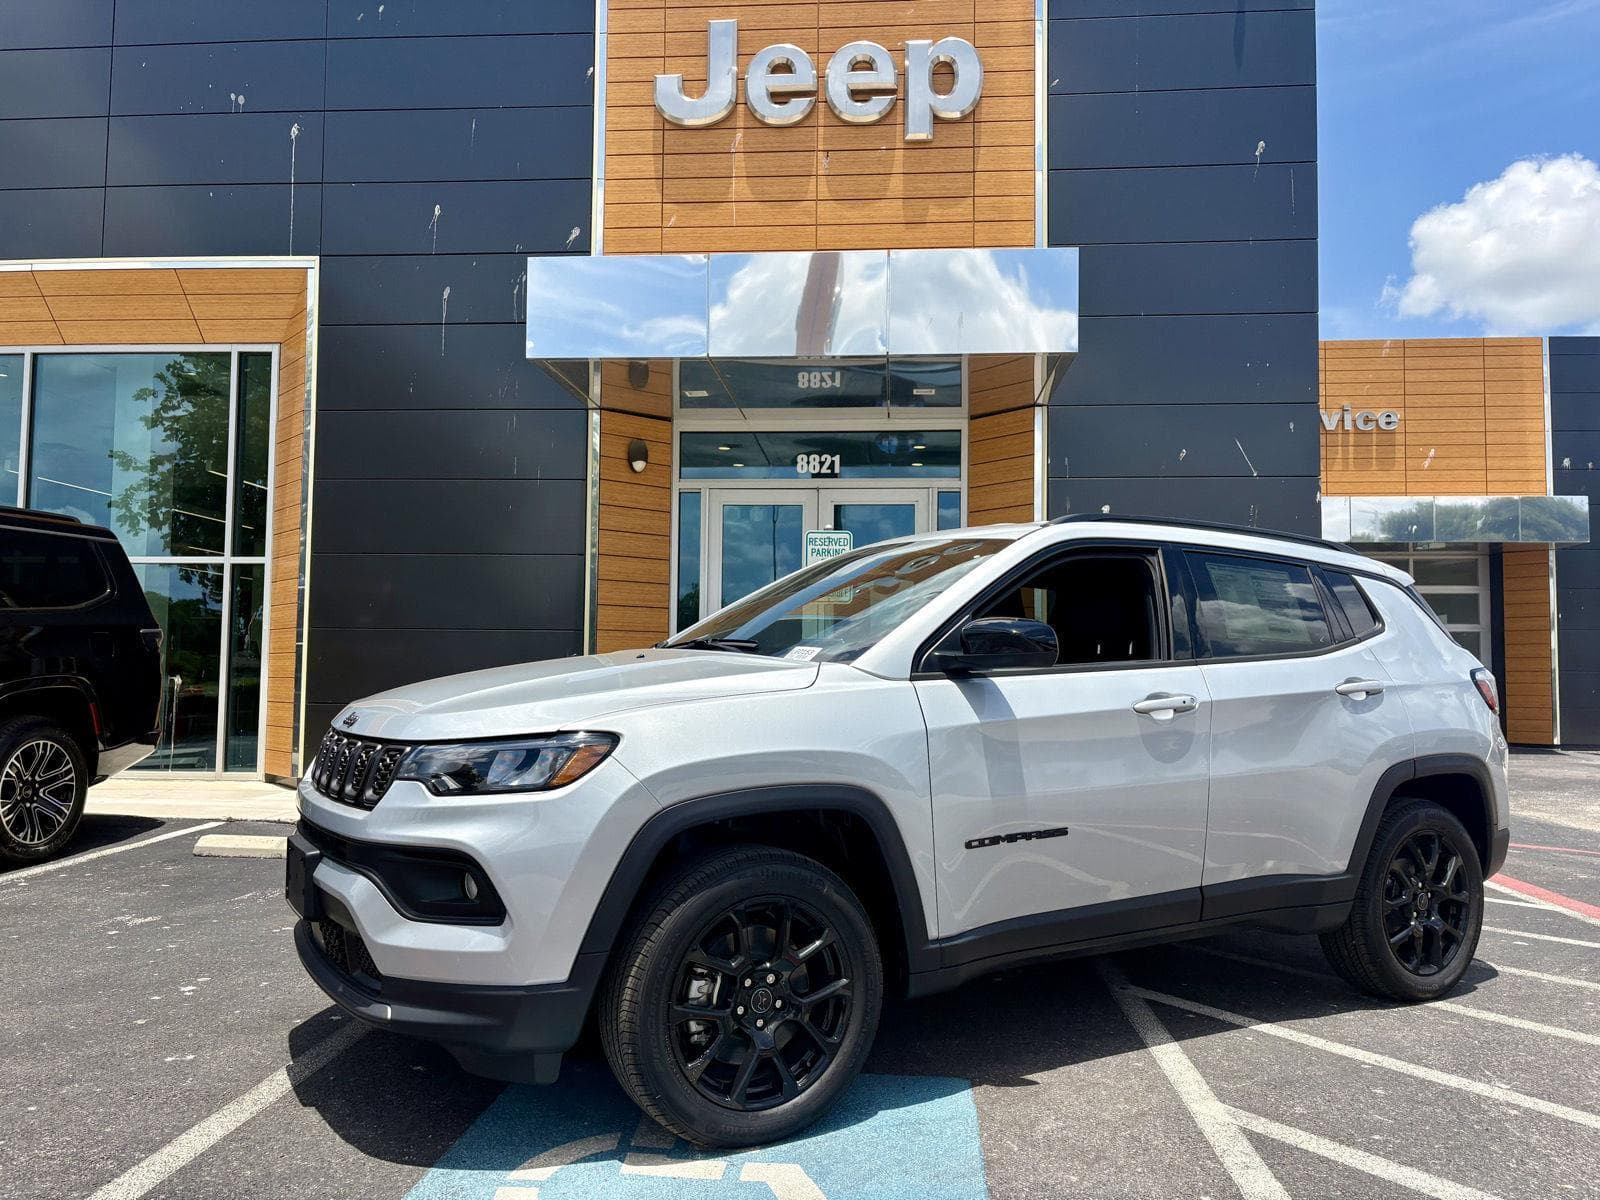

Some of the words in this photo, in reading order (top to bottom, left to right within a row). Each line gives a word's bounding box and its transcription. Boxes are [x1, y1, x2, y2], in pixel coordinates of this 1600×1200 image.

[653, 18, 984, 142] Jeep
[1320, 403, 1400, 430] vice
[796, 454, 840, 474] 8821
[808, 537, 848, 546] RESERVED
